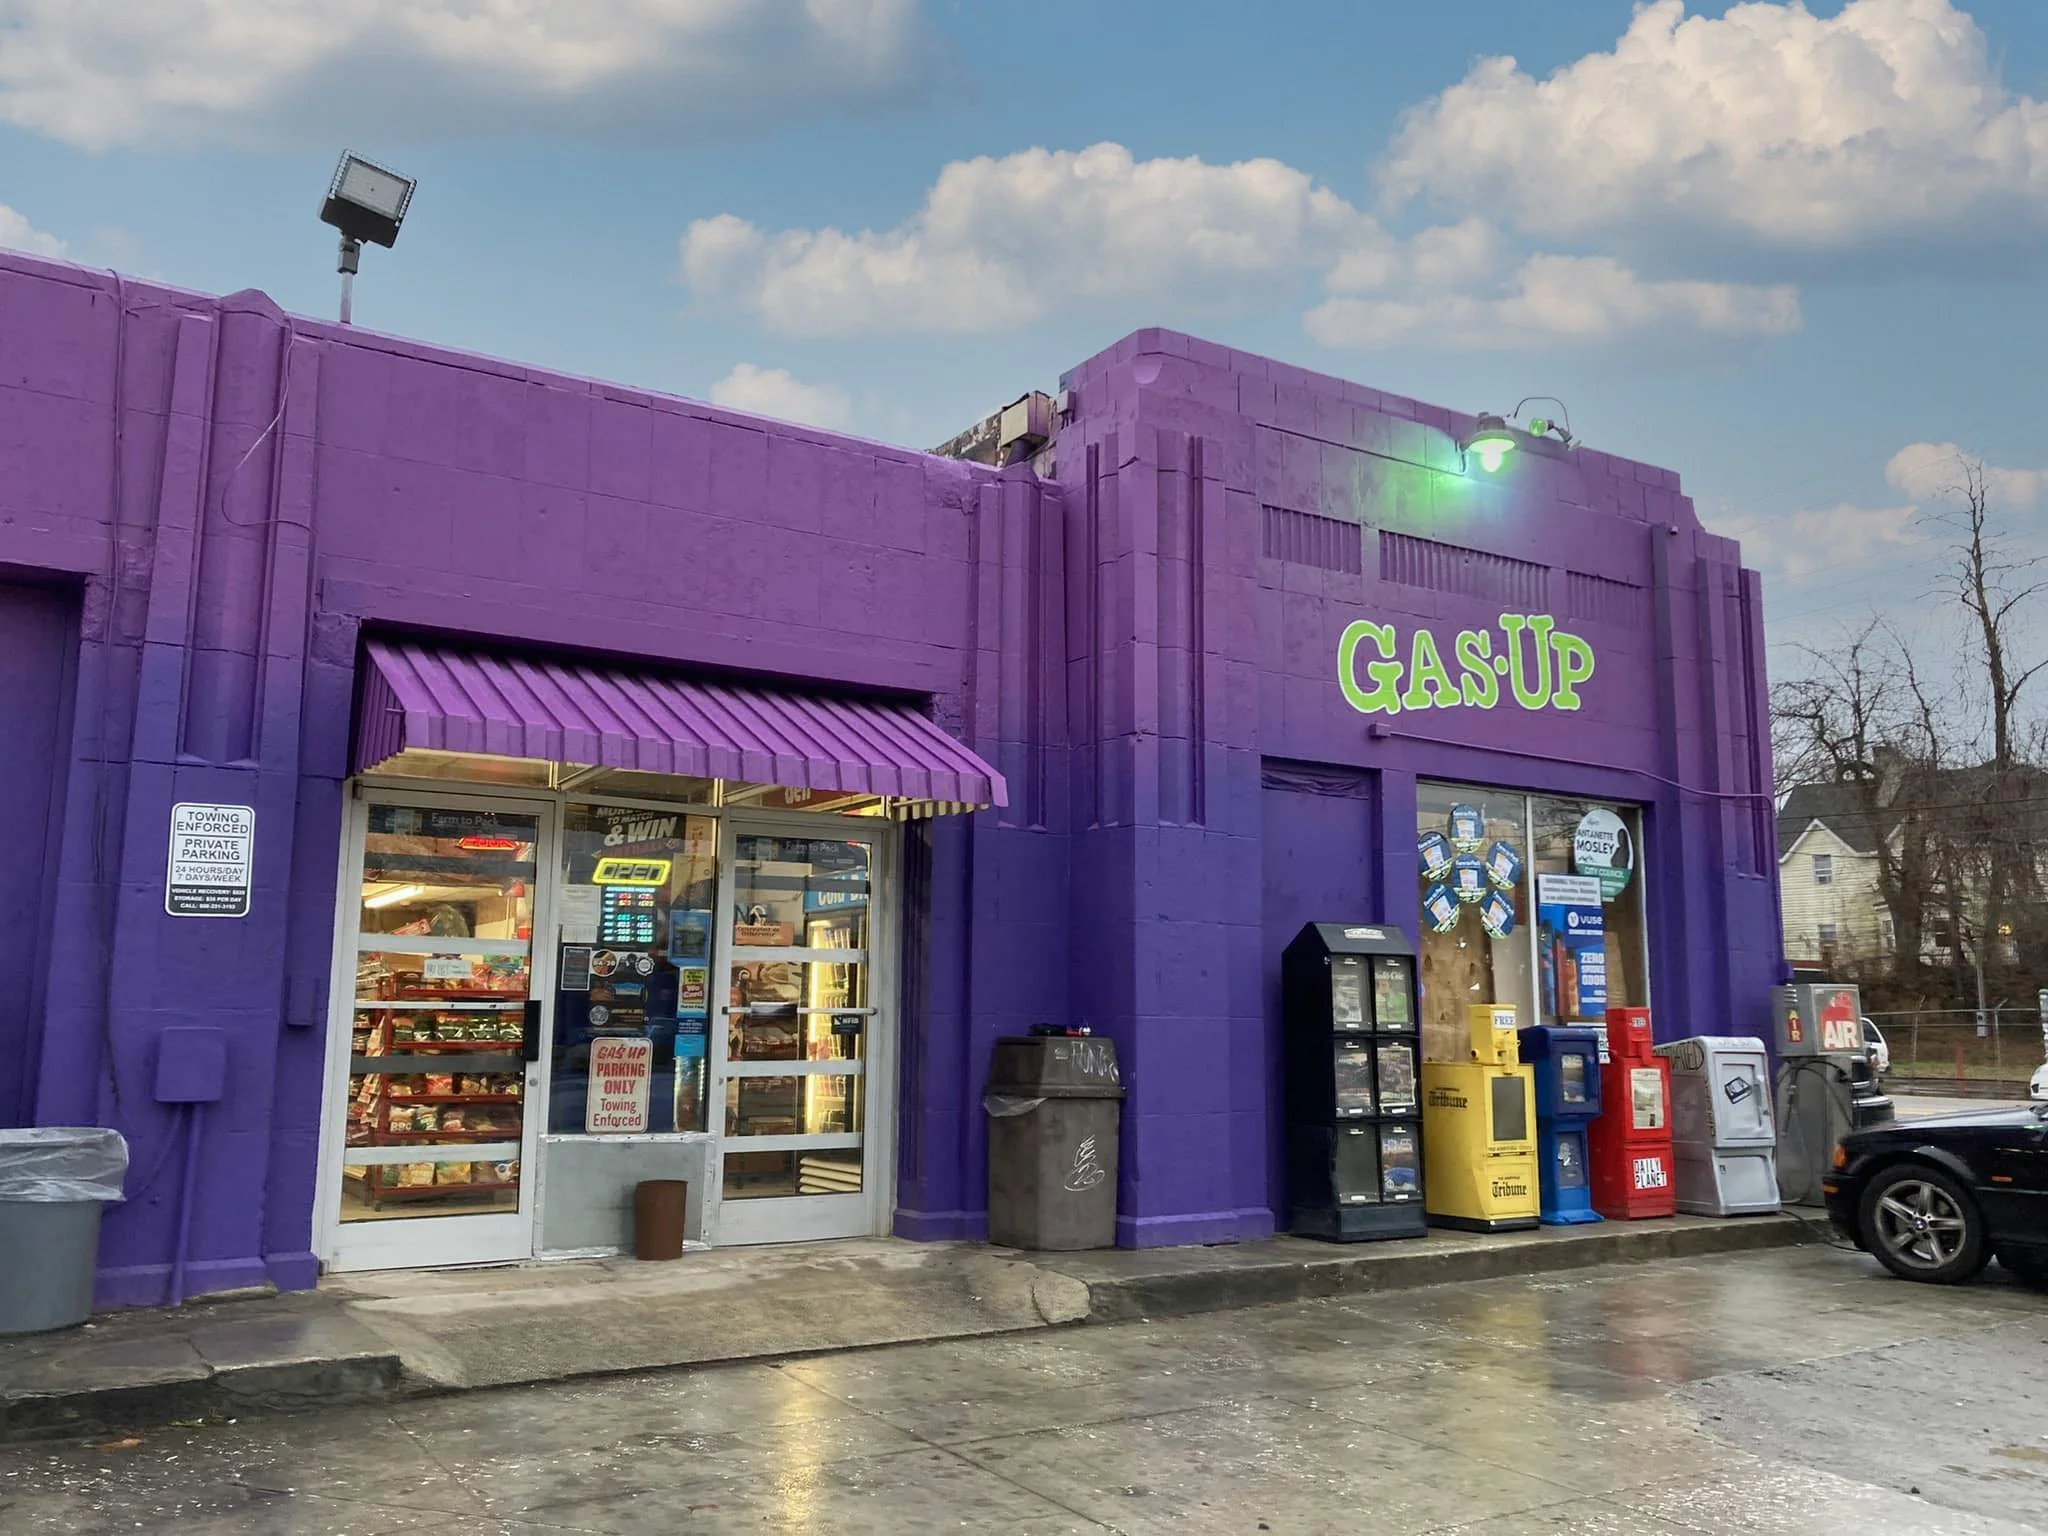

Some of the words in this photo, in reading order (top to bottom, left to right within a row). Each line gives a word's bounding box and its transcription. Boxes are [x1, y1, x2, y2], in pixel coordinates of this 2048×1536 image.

[188, 811, 240, 823] TOWING
[177, 821, 249, 834] ENFORCED
[603, 824, 625, 847] &
[626, 816, 683, 843] WIN
[185, 838, 239, 850] PRIVATE
[1576, 840, 1615, 854] MOSLEY
[181, 848, 241, 861] PARKING
[175, 865, 186, 873] 24
[188, 866, 245, 876] HOURS/DAY
[600, 863, 664, 880] OPEN
[185, 873, 242, 883] DAYS/WEEK
[1494, 1016, 1515, 1026] FREE
[1788, 1009, 1801, 1042] AIR
[1824, 1020, 1860, 1049] AIR
[627, 1046, 647, 1059] UP
[596, 1063, 645, 1078] PARKING
[603, 1080, 636, 1095] ONLY
[600, 1098, 637, 1114] Towing
[593, 1113, 642, 1127] Enforced
[1634, 1160, 1660, 1174] DAILY
[1635, 1173, 1667, 1188] PLANET
[1492, 1180, 1527, 1198] Tribune
